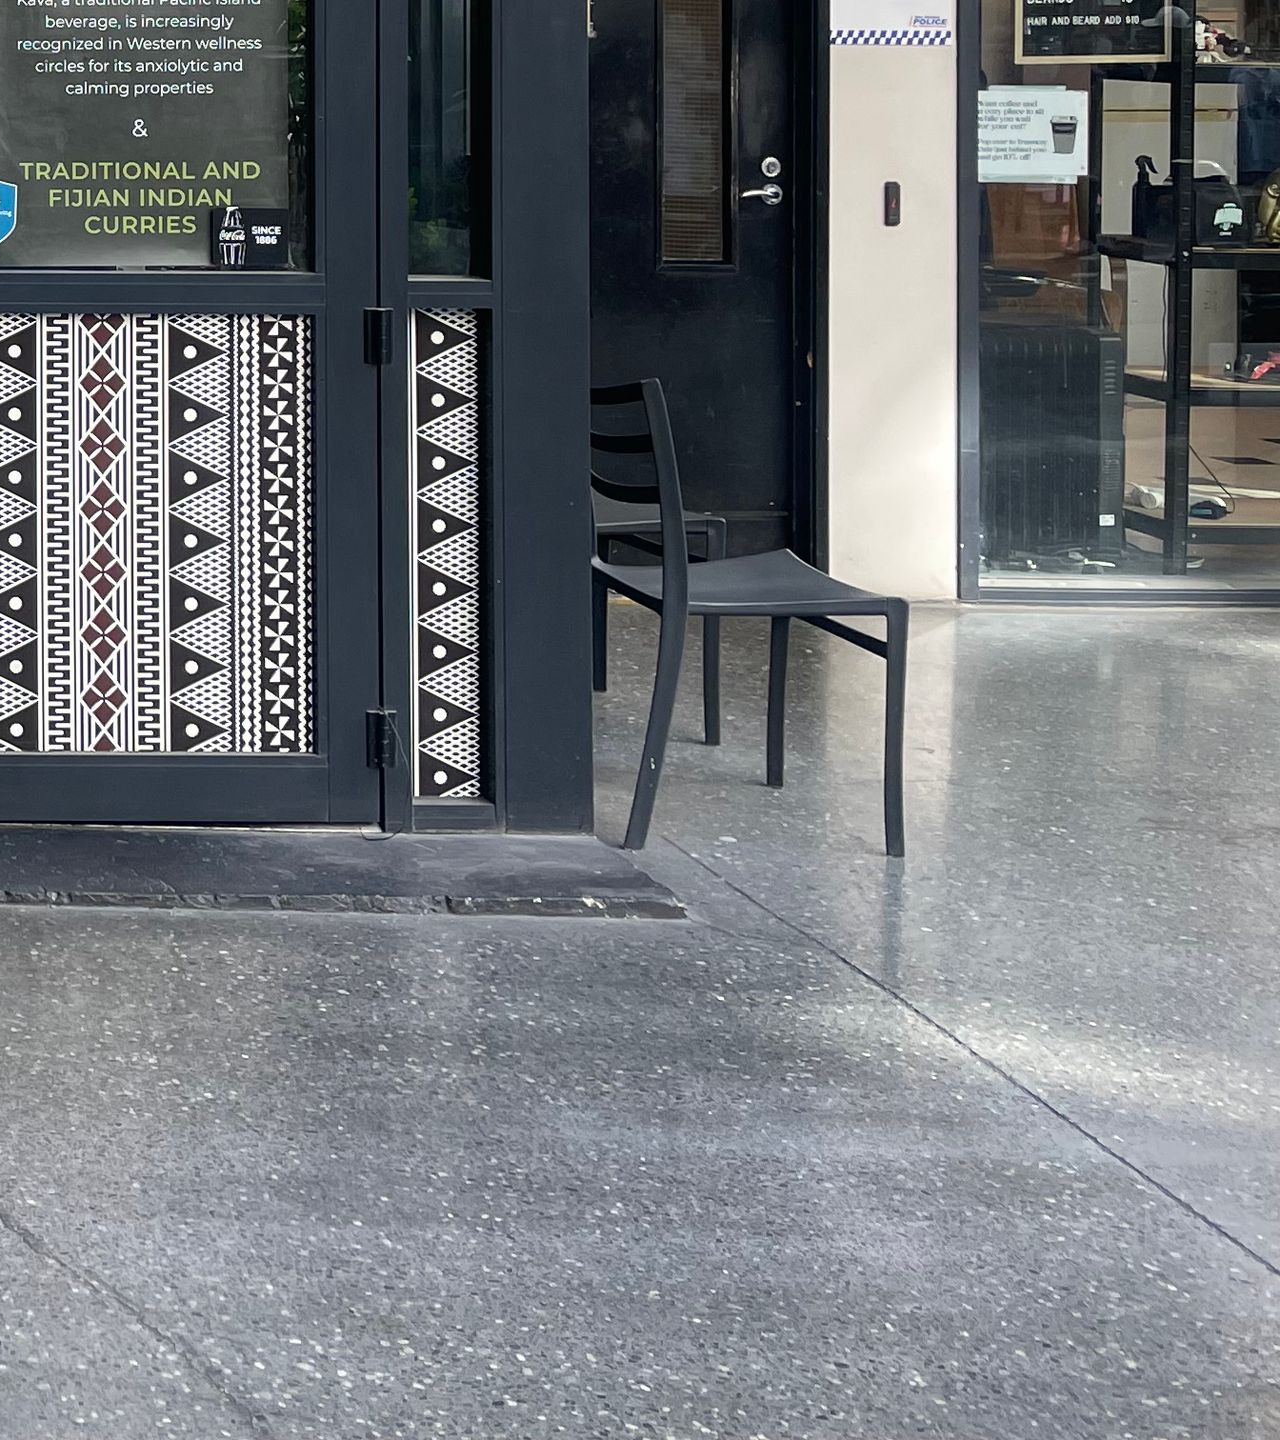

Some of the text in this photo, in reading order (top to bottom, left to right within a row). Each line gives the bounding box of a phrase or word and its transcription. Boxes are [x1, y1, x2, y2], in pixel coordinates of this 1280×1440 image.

[45, 14, 234, 32] beverage, is increasingly
[1052, 16, 1070, 26] AND
[1073, 16, 1100, 25] BEARD
[1105, 15, 1121, 24] ADD
[17, 36, 262, 54] recognized in Western wellness
[35, 58, 243, 76] circles for its anxiolytic and
[65, 80, 213, 98] calming properties
[132, 119, 148, 137] &
[19, 161, 261, 180] TRADITIONAL AND
[49, 188, 232, 207] FIJIAN INDIAN
[84, 216, 197, 234] CURRIES
[251, 226, 281, 234] SINCE
